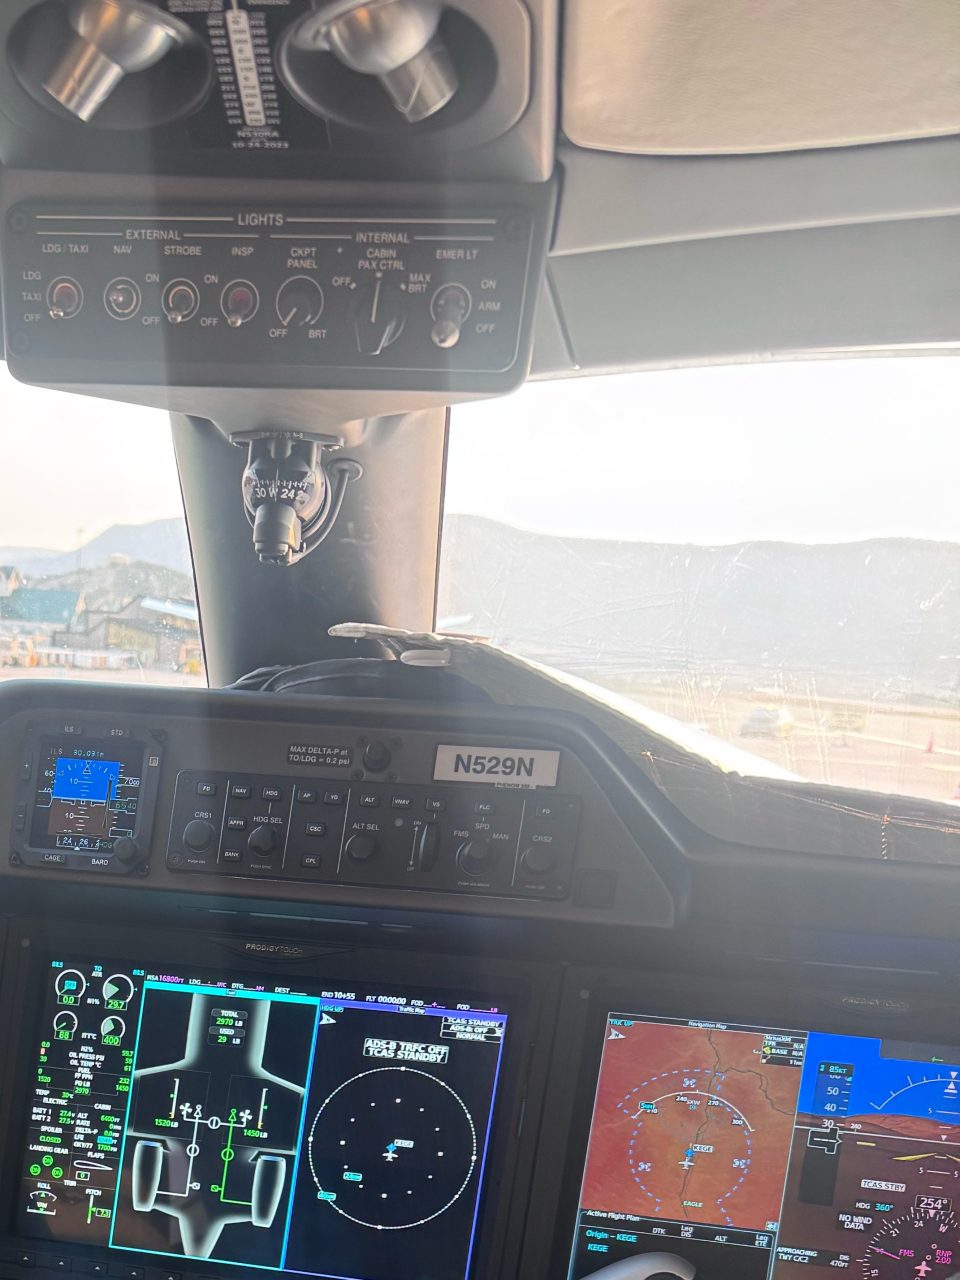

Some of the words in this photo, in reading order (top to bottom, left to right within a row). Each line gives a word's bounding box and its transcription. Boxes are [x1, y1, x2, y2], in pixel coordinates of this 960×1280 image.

[237, 213, 284, 226] LIGHTS
[125, 230, 181, 241] EXTERNAL
[355, 232, 410, 244] INTERNAL
[113, 245, 132, 255] NAV
[164, 246, 202, 256] STROBE
[231, 247, 254, 256] INSP
[290, 247, 317, 257] CKPT
[366, 248, 397, 258] CABIN
[435, 249, 465, 259] EMER
[287, 259, 318, 270] PANEL
[358, 260, 377, 270] PAX
[380, 261, 405, 271] CTRL
[23, 271, 41, 281] LDG
[145, 273, 160, 283] ON
[204, 274, 219, 284] ON
[409, 274, 432, 283] MAX
[332, 276, 351, 287] OFF
[481, 280, 497, 289] ON
[408, 284, 428, 293] BRT
[22, 291, 41, 302] TAXI
[478, 302, 501, 311] ARM
[23, 313, 41, 322] OFF
[142, 316, 161, 326] OFF
[200, 317, 219, 327] OFF
[269, 328, 288, 338] OFF
[308, 329, 327, 339] BRT
[476, 324, 495, 334] OFF
[254, 488, 267, 498] 30
[280, 488, 296, 499] 24
[290, 745, 306, 753] MAX
[308, 746, 340, 755] DELTA-P
[338, 757, 350, 766] psi
[454, 753, 535, 777] N529N
[194, 811, 212, 819] CRS1
[253, 815, 268, 823] HDG
[270, 816, 283, 824] SEL
[366, 823, 380, 831] SEL
[475, 822, 490, 830] SPD
[453, 830, 470, 838] FMS
[492, 833, 509, 841] MAN
[532, 834, 553, 843] CRS2
[44, 854, 62, 862] CAGE
[91, 858, 109, 866] BARO
[216, 1018, 234, 1026] 2970
[103, 1035, 119, 1045] 400
[365, 1039, 397, 1050] ADS-B
[400, 1042, 425, 1053] TRFC
[428, 1044, 449, 1055] OFF
[368, 1047, 395, 1058] TCAS
[396, 1050, 444, 1063] STANDBY
[827, 1087, 839, 1095] 50
[824, 1103, 837, 1112] 40
[822, 1119, 834, 1128] 30
[863, 1180, 882, 1189] TCAS
[885, 1182, 905, 1191] STBY
[855, 1202, 871, 1210] HDG
[920, 1197, 948, 1209] 254°
[839, 1214, 852, 1222] NO
[852, 1215, 873, 1224] WIND
[844, 1222, 865, 1231] DATA
[586, 1230, 608, 1240] Origin
[616, 1233, 638, 1243] KEGE
[587, 1243, 609, 1253] KEGE
